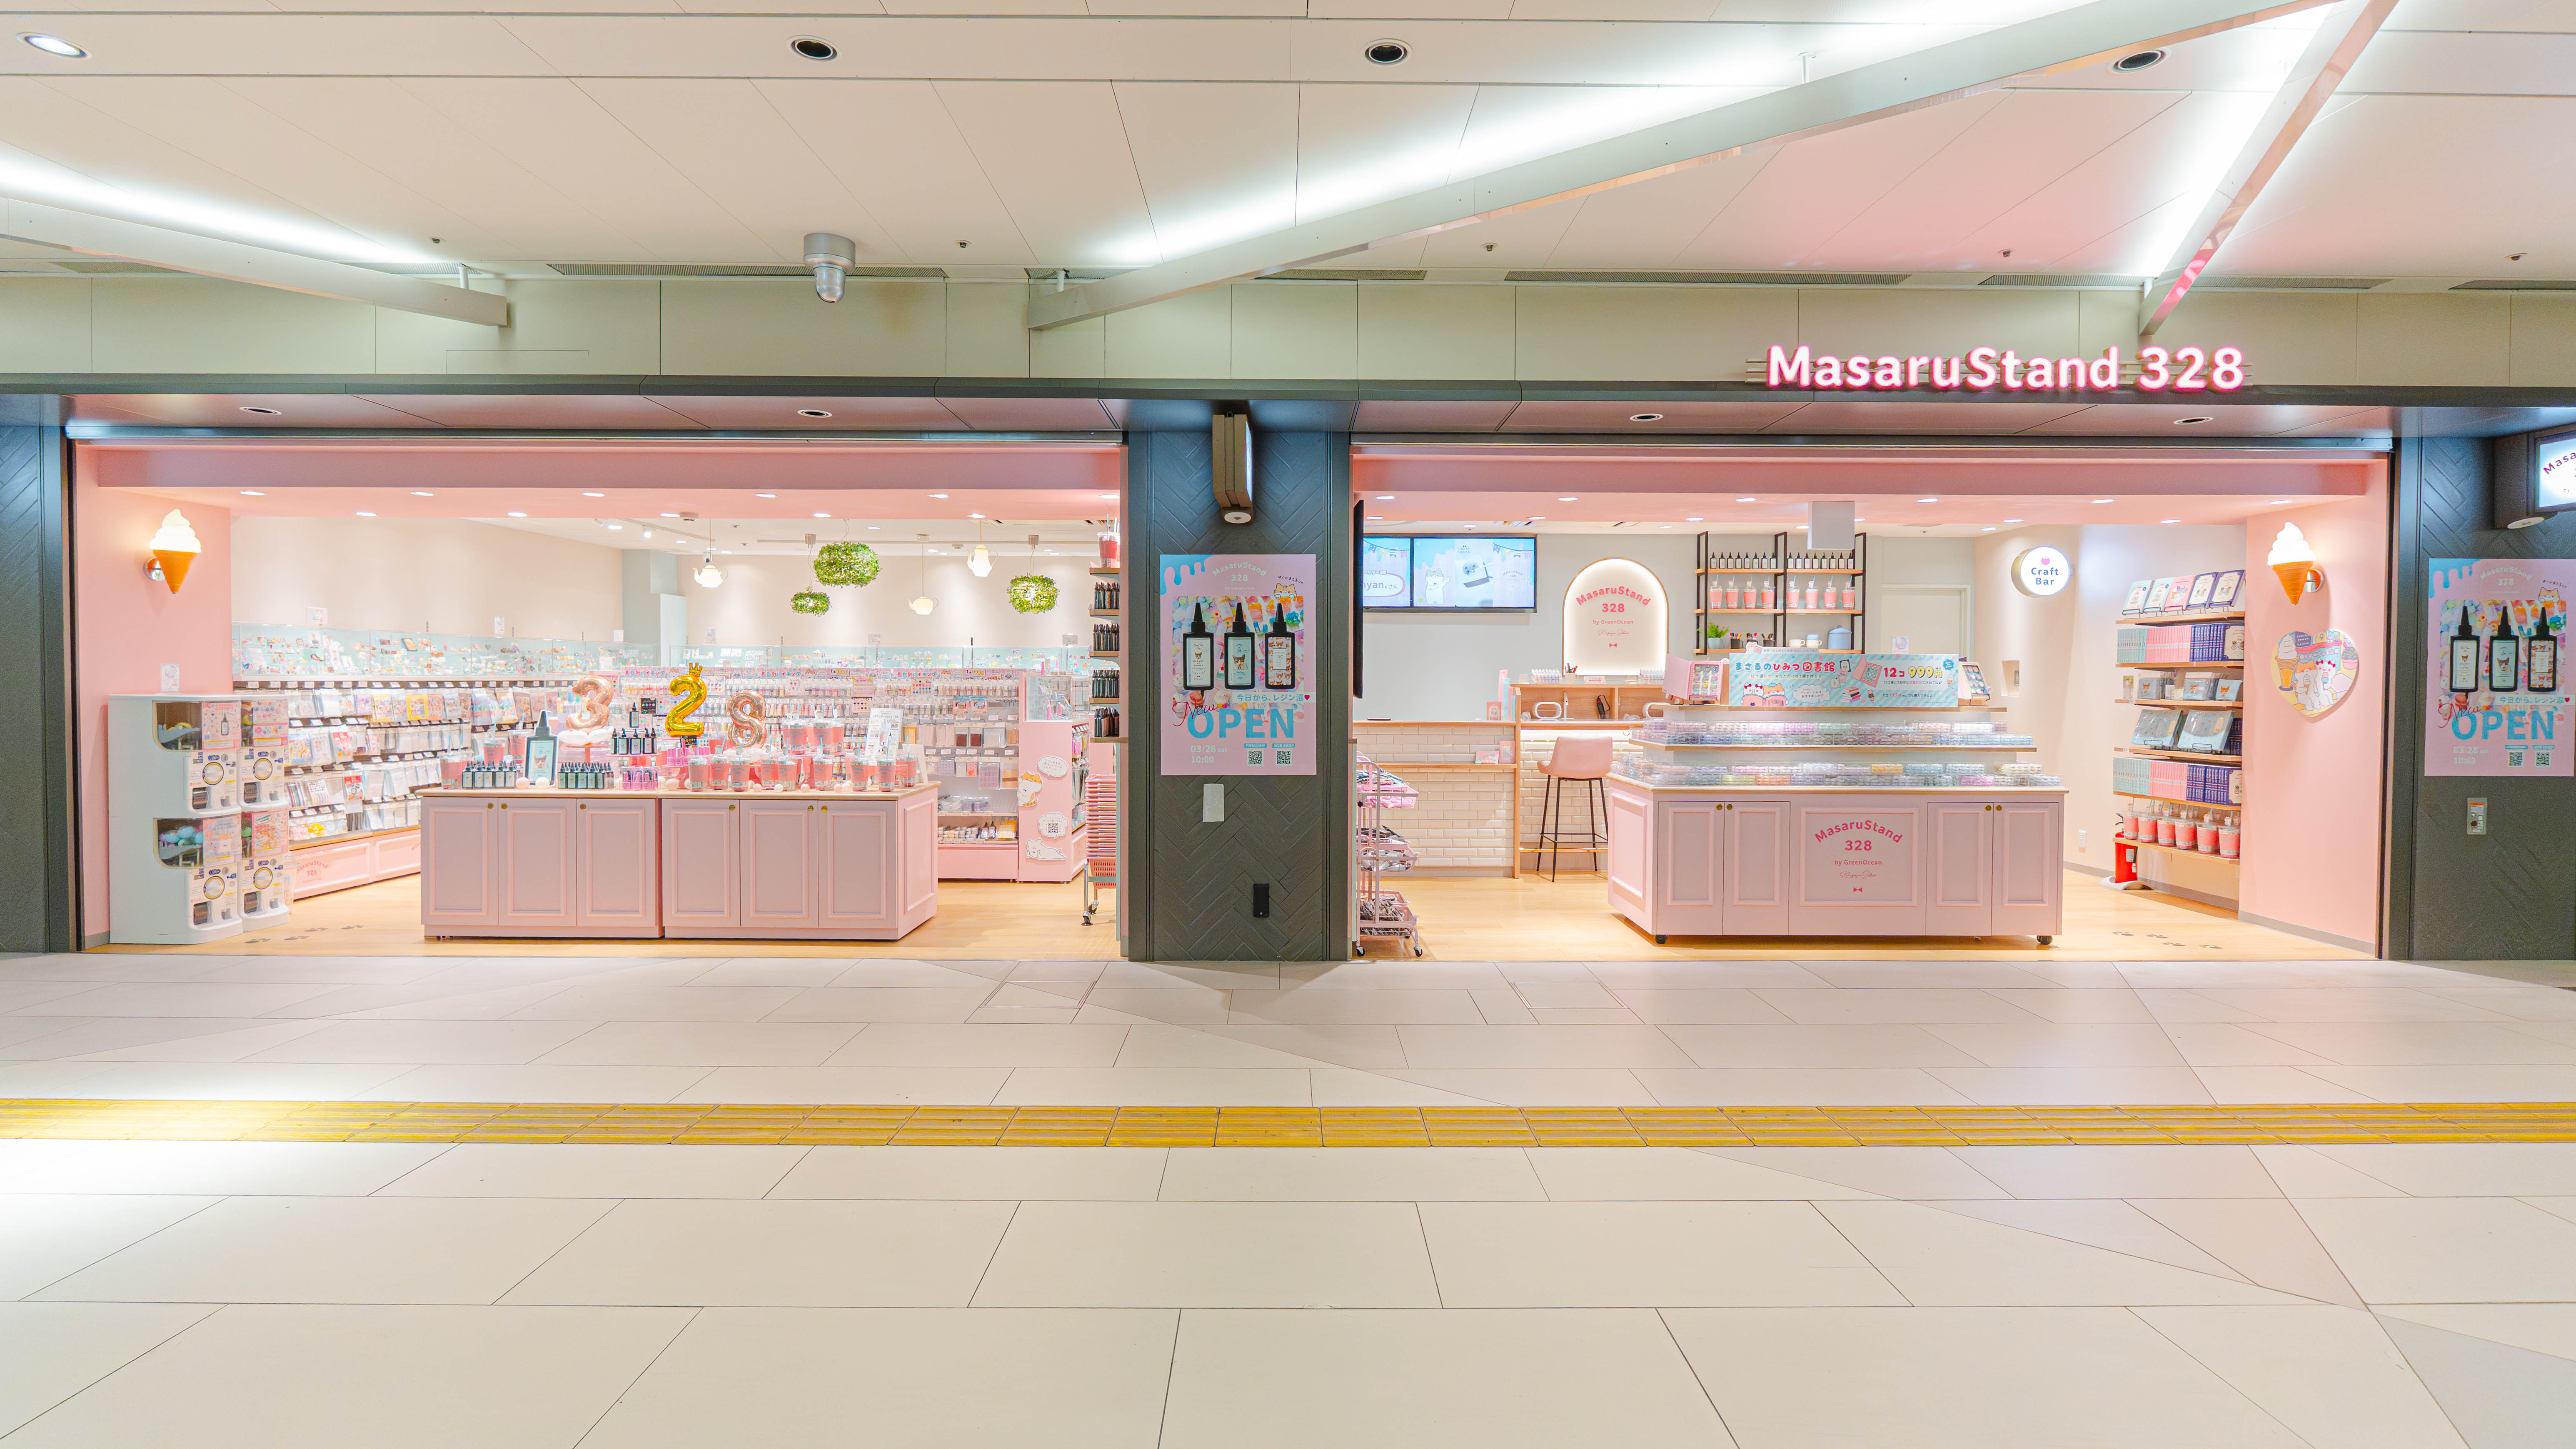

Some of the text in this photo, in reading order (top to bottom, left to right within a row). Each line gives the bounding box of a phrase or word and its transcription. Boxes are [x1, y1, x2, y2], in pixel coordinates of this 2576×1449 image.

[1767, 344, 2246, 391] MasaruStand 328
[1213, 562, 1267, 576] MasaruStand
[2031, 567, 2059, 576] Craft
[1576, 586, 1651, 606] MasaruStand
[1602, 604, 1625, 613] 328
[1735, 661, 1835, 672] まさるのひみつ図書館
[566, 674, 767, 749] 3 2 8
[1172, 701, 1217, 727] New
[2438, 703, 2482, 728] New
[1187, 708, 1294, 739] OPEN
[2451, 710, 2554, 740] OPEN
[1190, 745, 1216, 753] 03/28
[1815, 820, 1903, 843] MasaruStand
[1845, 840, 1872, 851] 328
